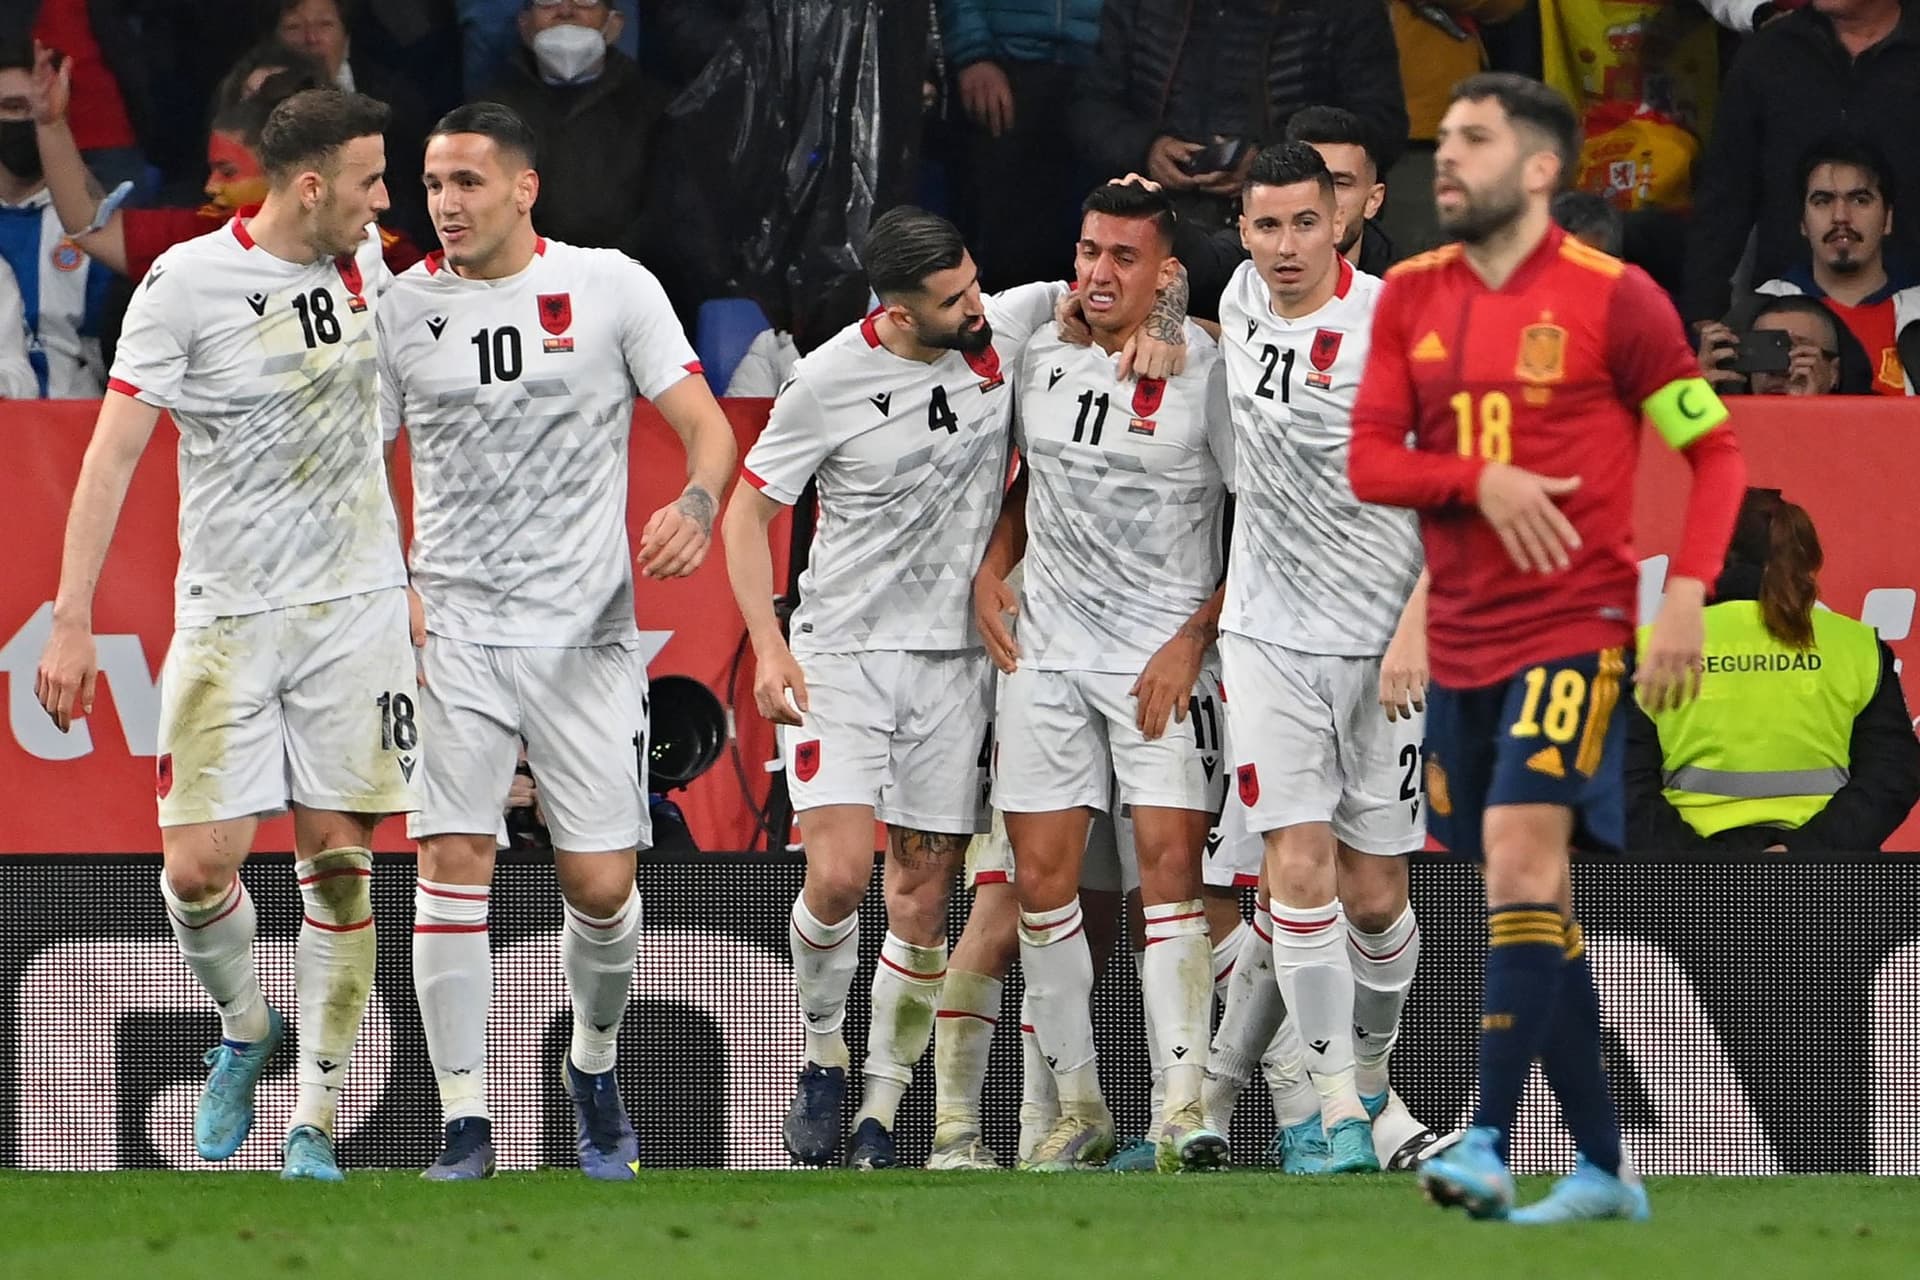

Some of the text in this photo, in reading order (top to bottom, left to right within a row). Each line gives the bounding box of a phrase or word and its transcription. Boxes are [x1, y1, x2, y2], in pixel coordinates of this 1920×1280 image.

[292, 287, 341, 348] 18
[471, 325, 523, 384] 10
[1255, 343, 1295, 403] 21
[928, 385, 958, 435] 4
[1072, 390, 1109, 446] 11
[1450, 391, 1512, 466] 18
[1677, 387, 1706, 420] C
[376, 691, 417, 751] 18
[1188, 695, 1219, 751] 11
[1509, 666, 1586, 744] 18
[977, 721, 992, 777] 4
